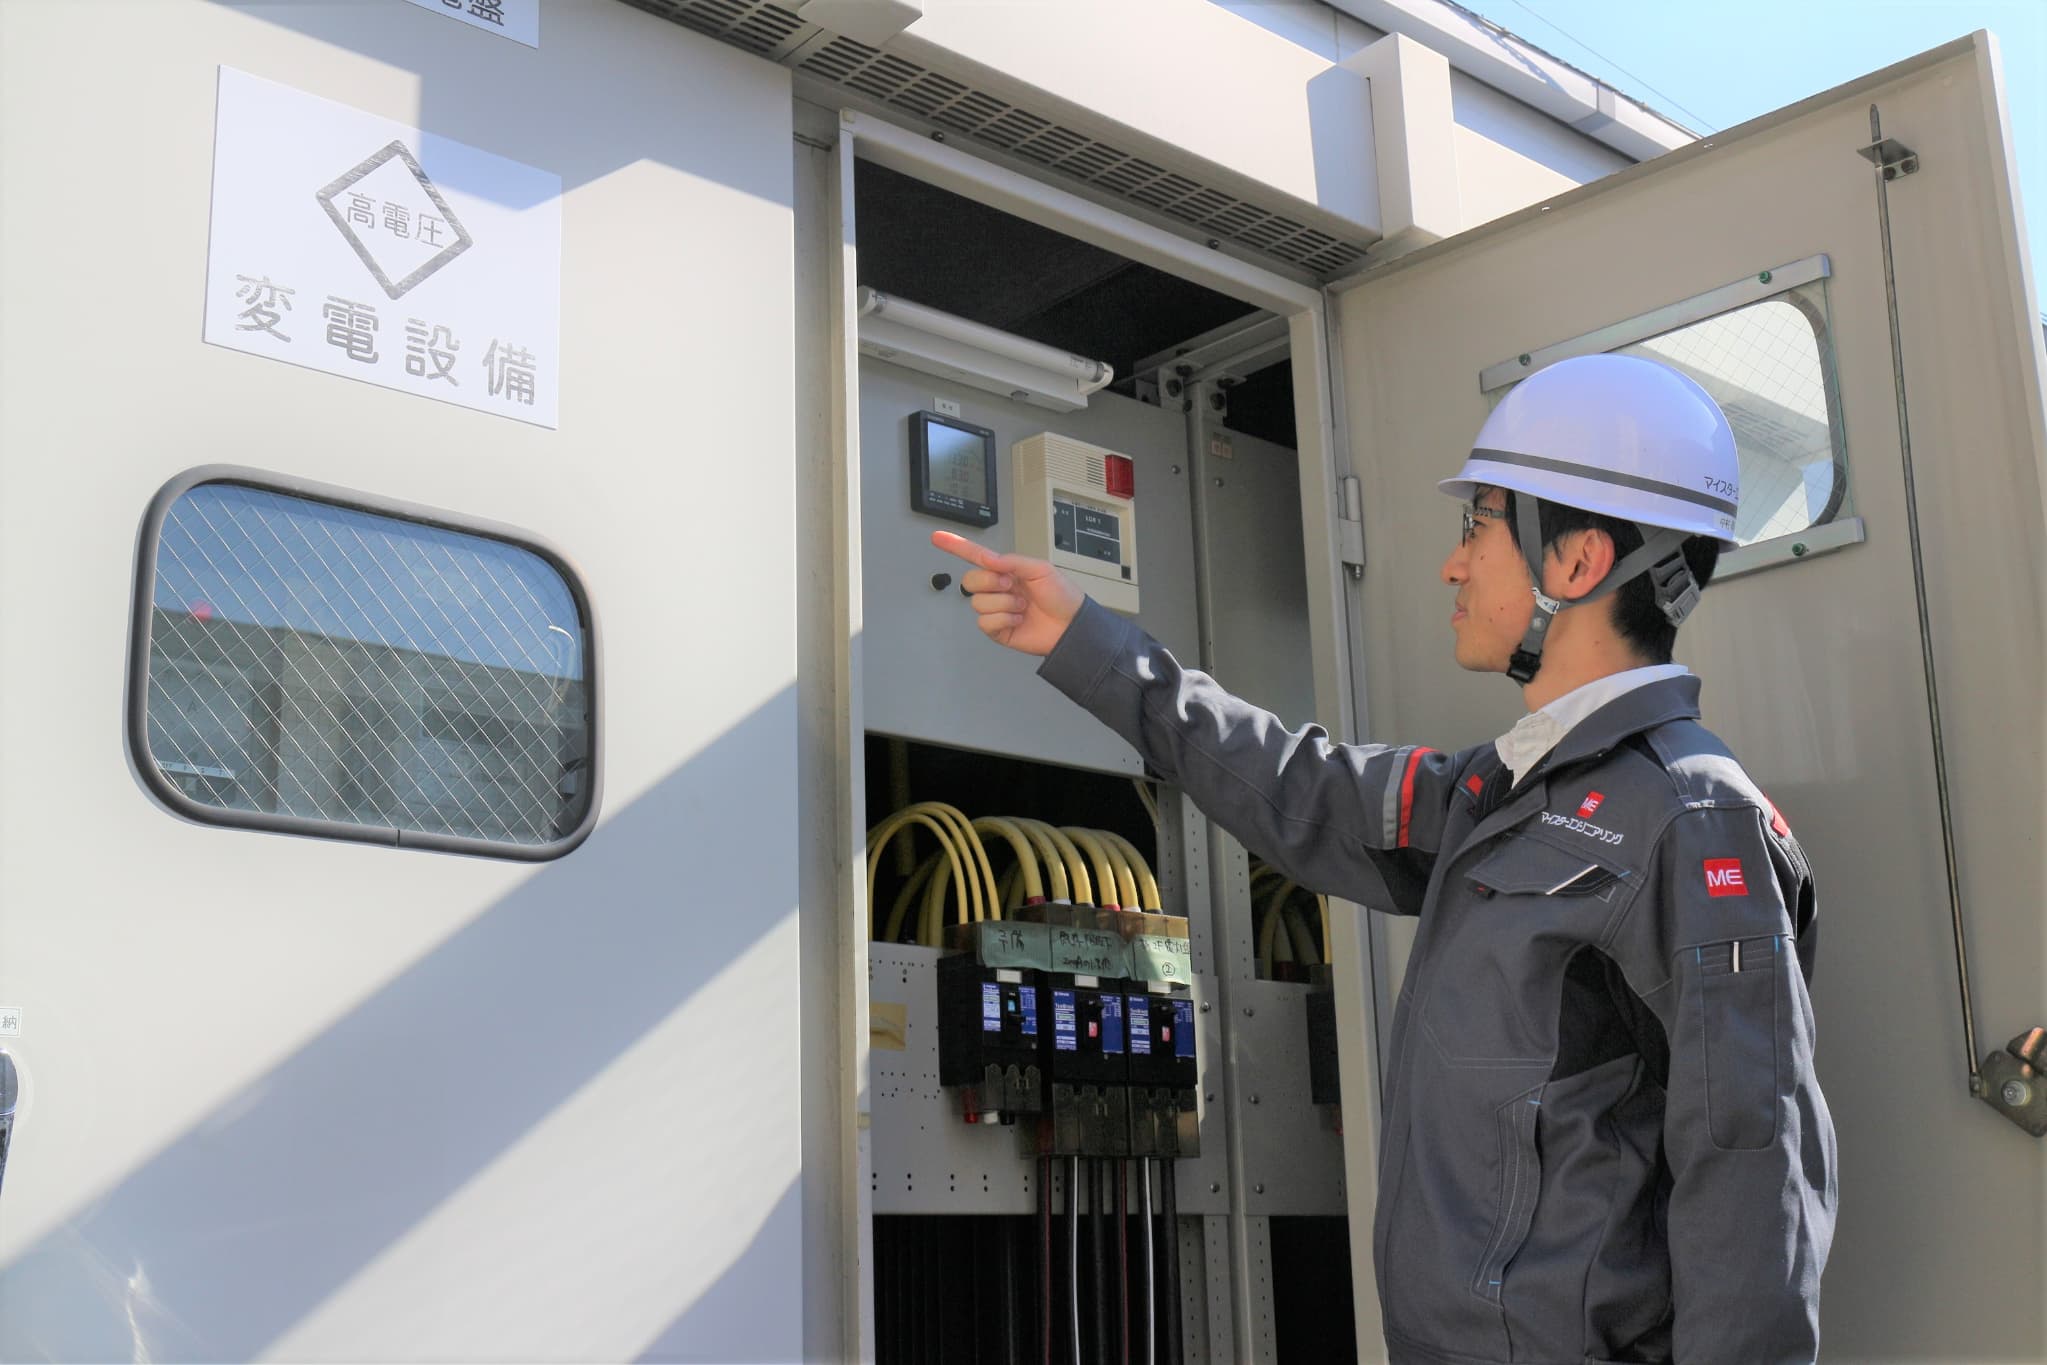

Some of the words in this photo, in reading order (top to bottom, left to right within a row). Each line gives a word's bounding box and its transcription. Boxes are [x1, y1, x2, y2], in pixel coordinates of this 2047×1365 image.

[442, 0, 505, 27] 盤
[346, 191, 446, 249] 高電圧
[235, 273, 537, 407] 変電設備
[1580, 797, 1600, 812] ME
[1541, 811, 1625, 846] マイスターエンジニアリング
[1706, 868, 1744, 888] ME
